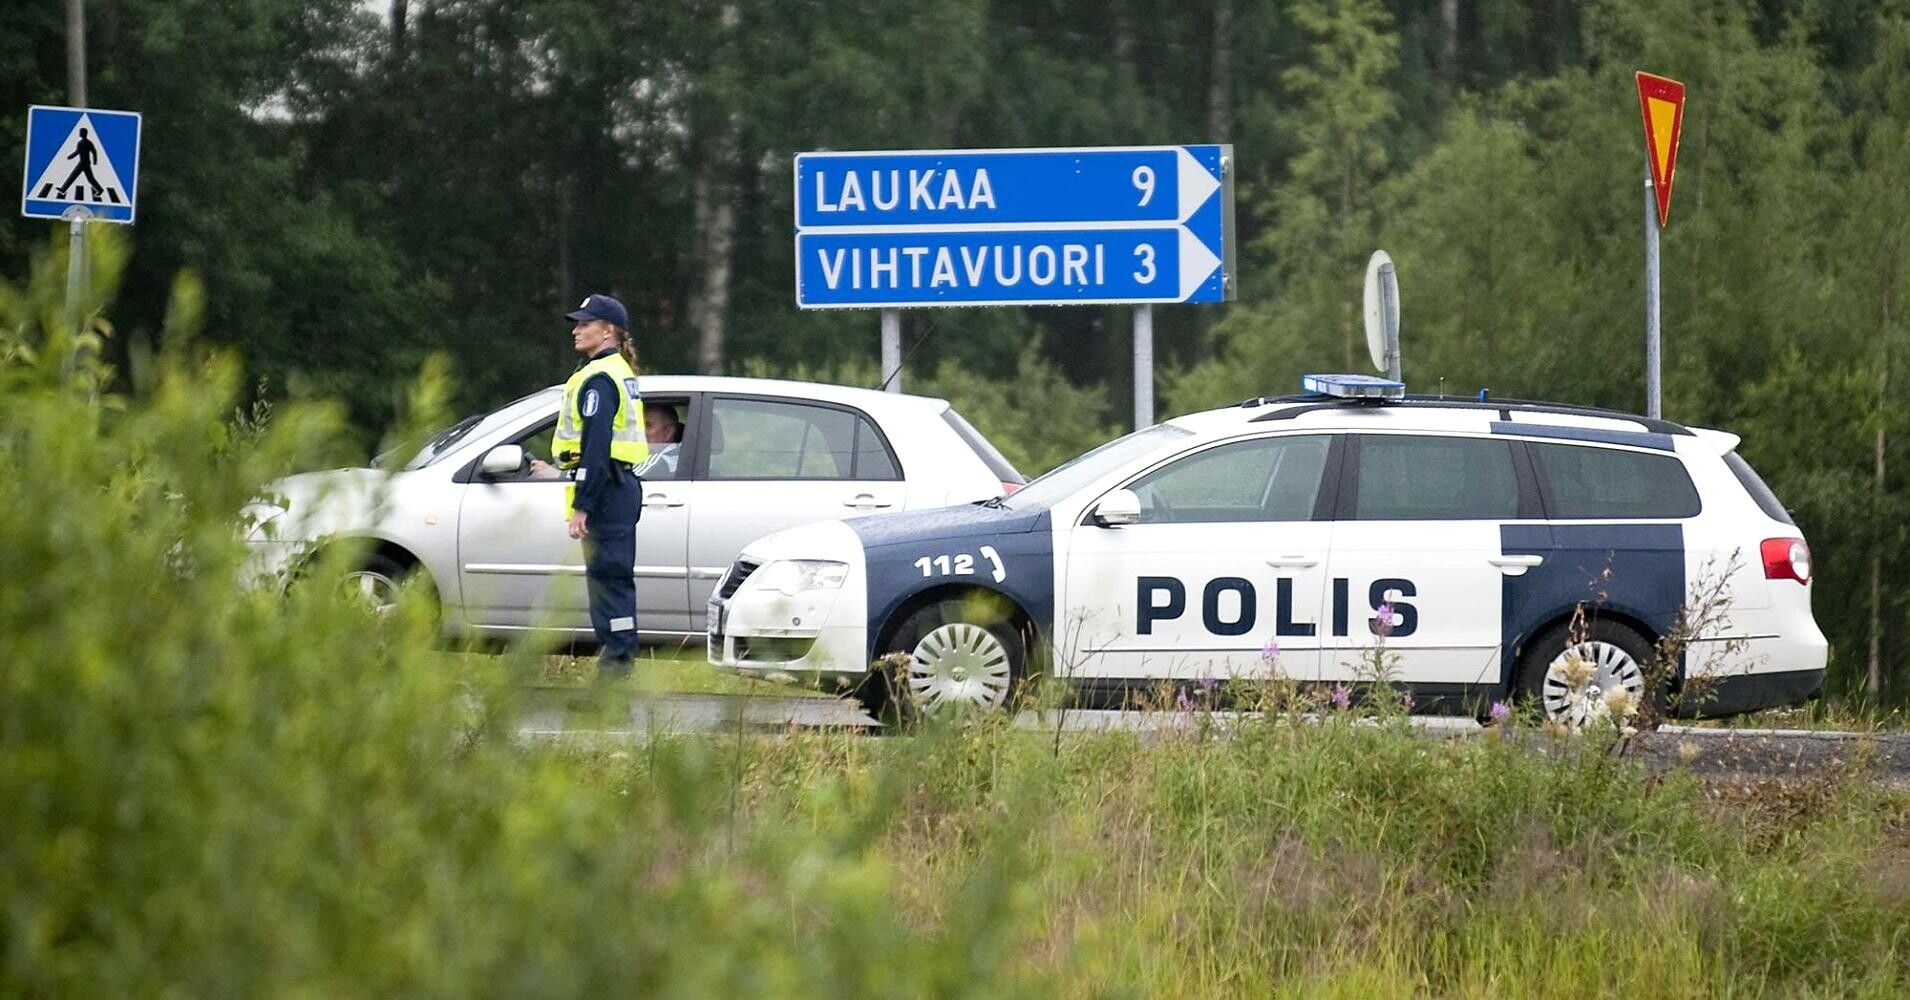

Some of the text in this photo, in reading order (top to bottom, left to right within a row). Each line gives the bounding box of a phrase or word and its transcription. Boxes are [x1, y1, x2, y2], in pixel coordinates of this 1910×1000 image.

[815, 166, 1155, 212] LAUKAA 9
[818, 243, 1156, 289] VIHTAVUORI 3
[914, 553, 975, 577] 112
[1136, 576, 1419, 637] POLIS
